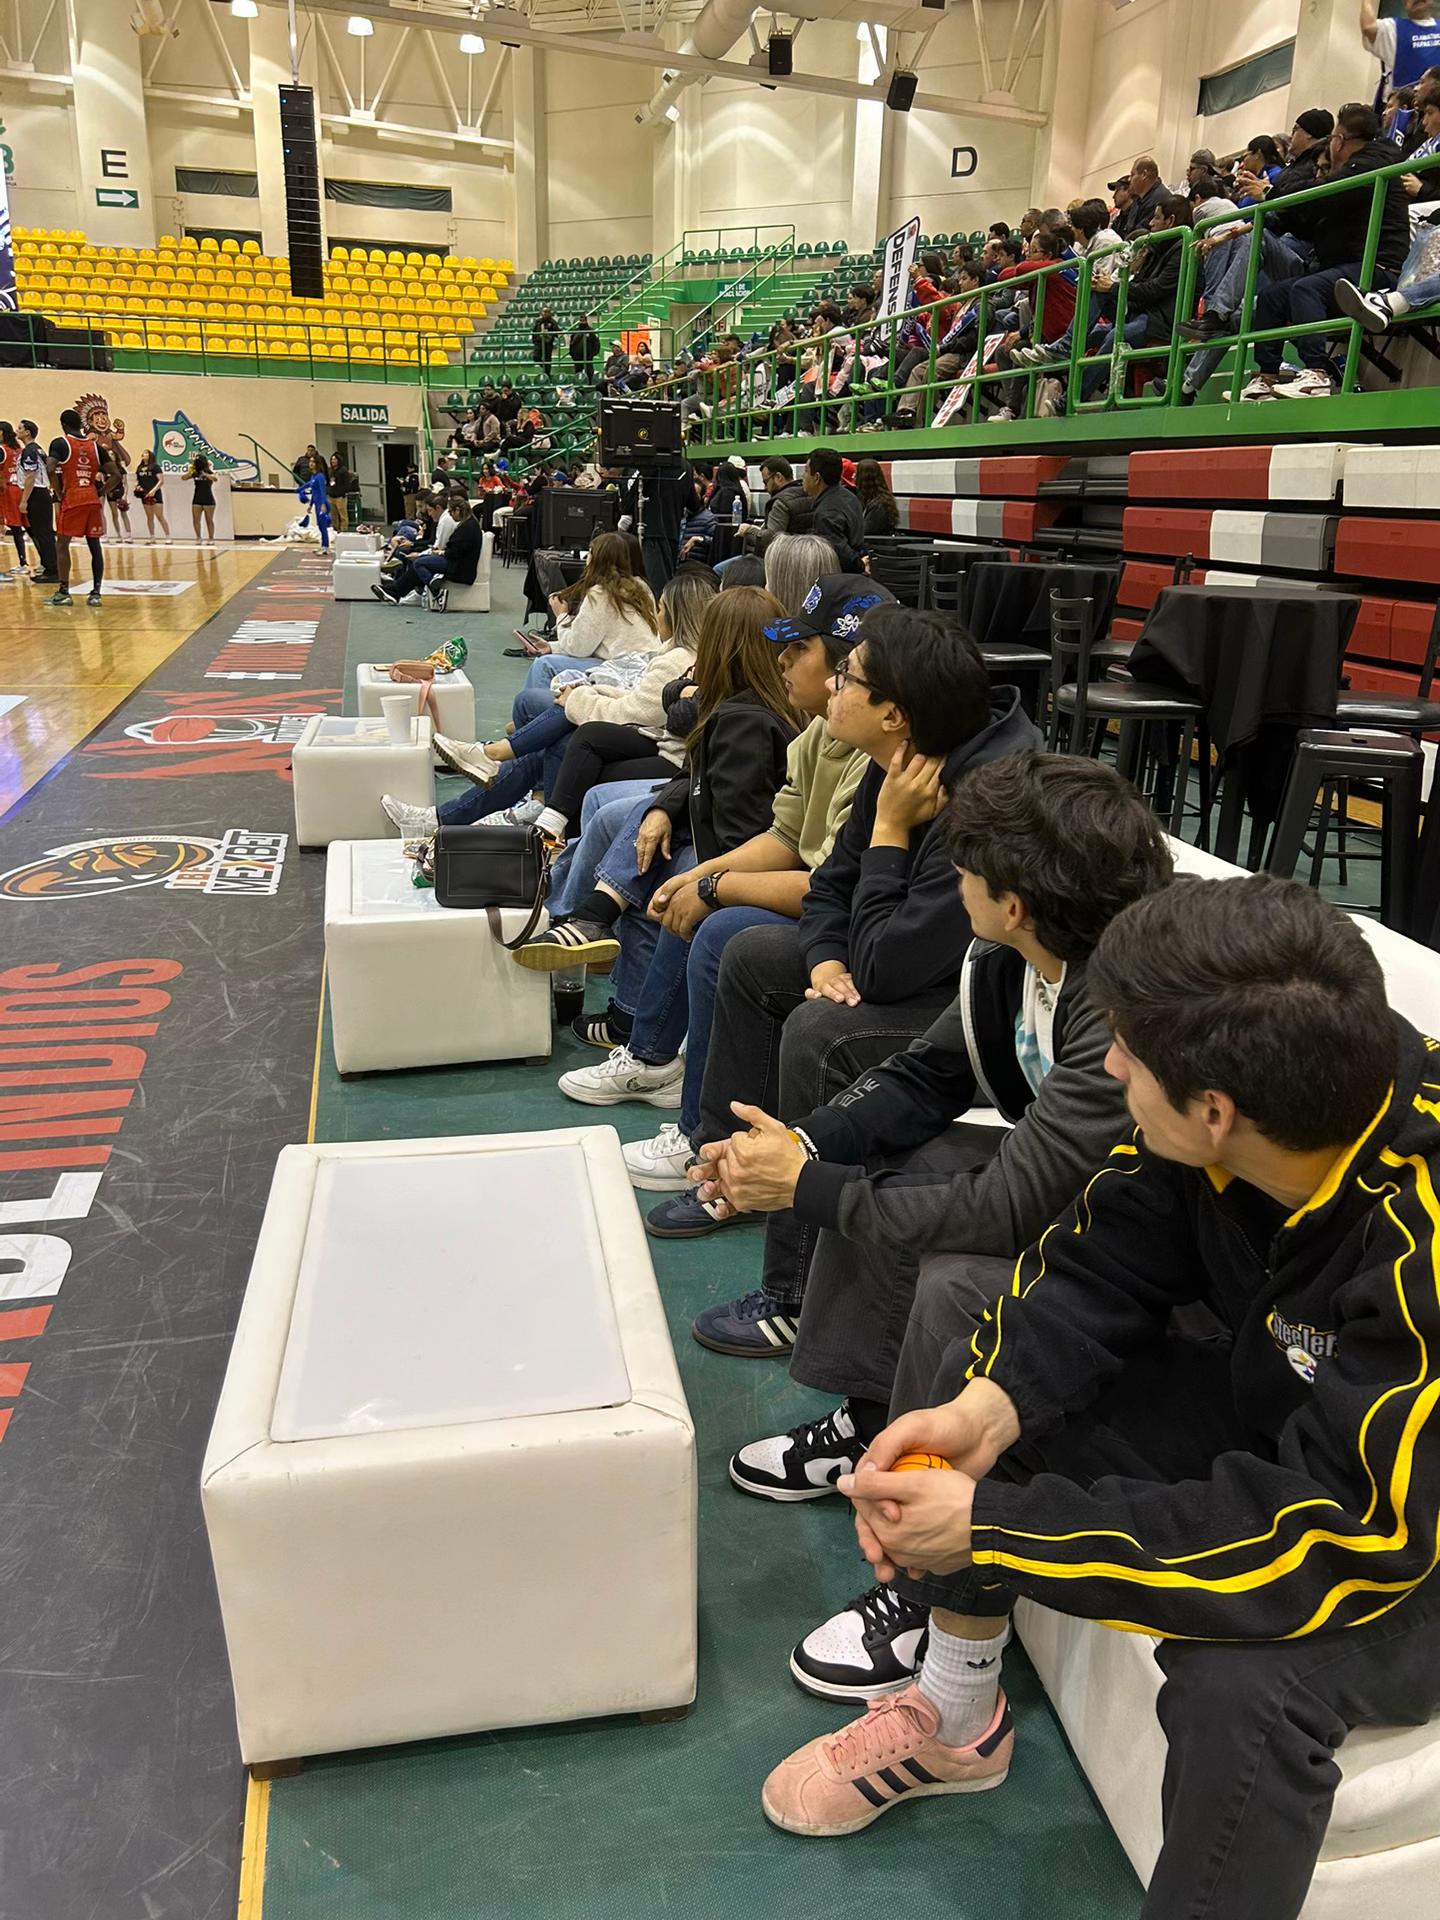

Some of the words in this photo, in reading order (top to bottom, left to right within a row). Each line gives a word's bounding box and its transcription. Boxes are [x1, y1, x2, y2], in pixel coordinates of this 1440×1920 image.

[102, 150, 128, 178] E
[951, 147, 978, 177] D
[343, 407, 387, 421] SALIDA
[163, 462, 188, 472] Bord
[211, 831, 280, 892] MEXBET
